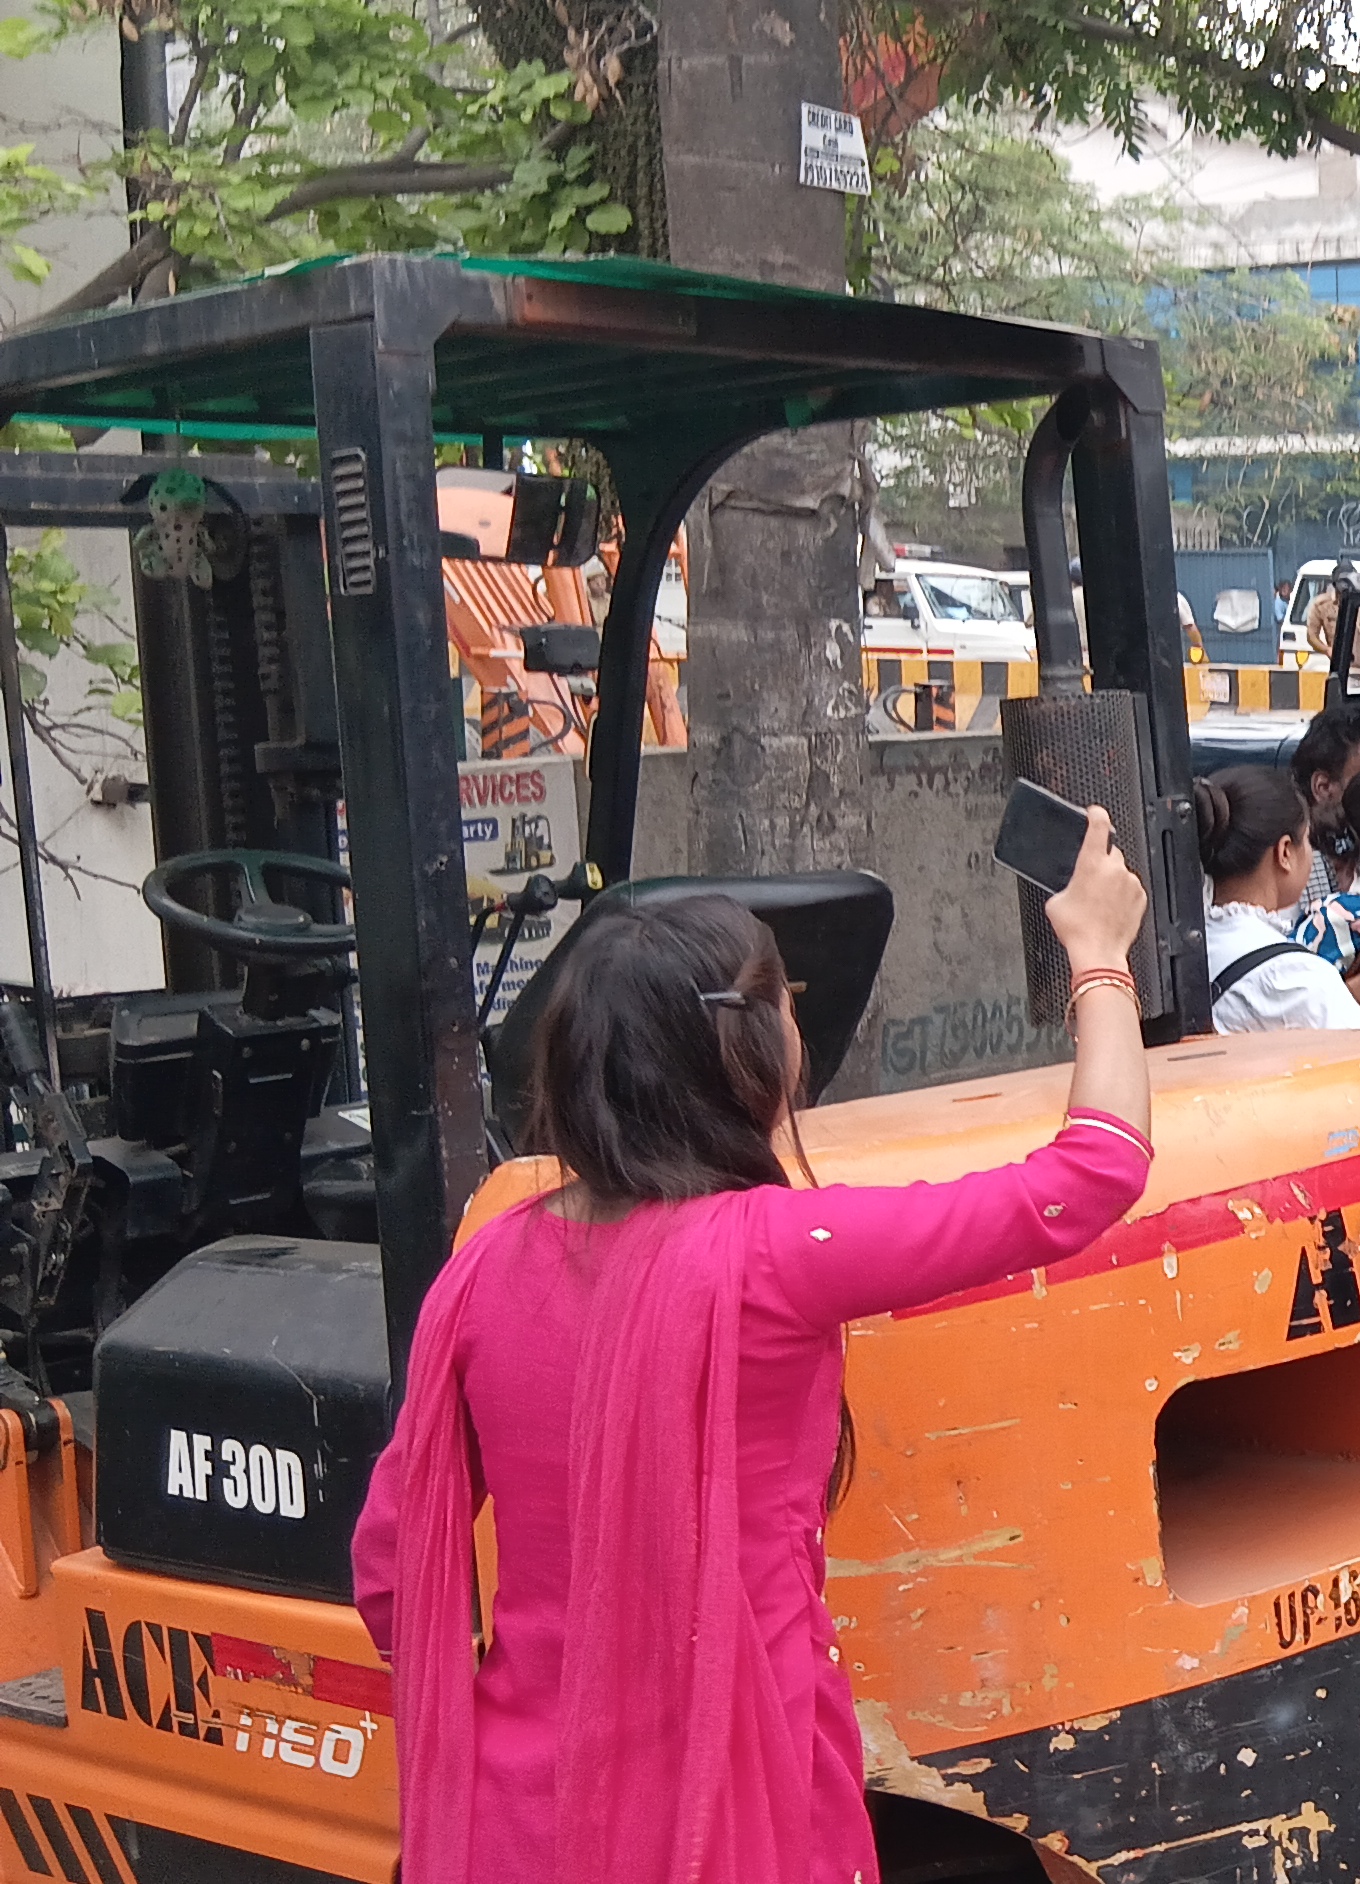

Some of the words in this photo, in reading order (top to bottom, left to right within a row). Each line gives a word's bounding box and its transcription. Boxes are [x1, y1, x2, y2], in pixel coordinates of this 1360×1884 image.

[807, 106, 832, 130] CREDIT
[835, 112, 854, 137] CARD
[458, 769, 547, 809] RVICES
[462, 821, 494, 841] arty
[167, 1428, 213, 1502] AF
[221, 1438, 307, 1520] 30D
[80, 1606, 224, 1747] ACE
